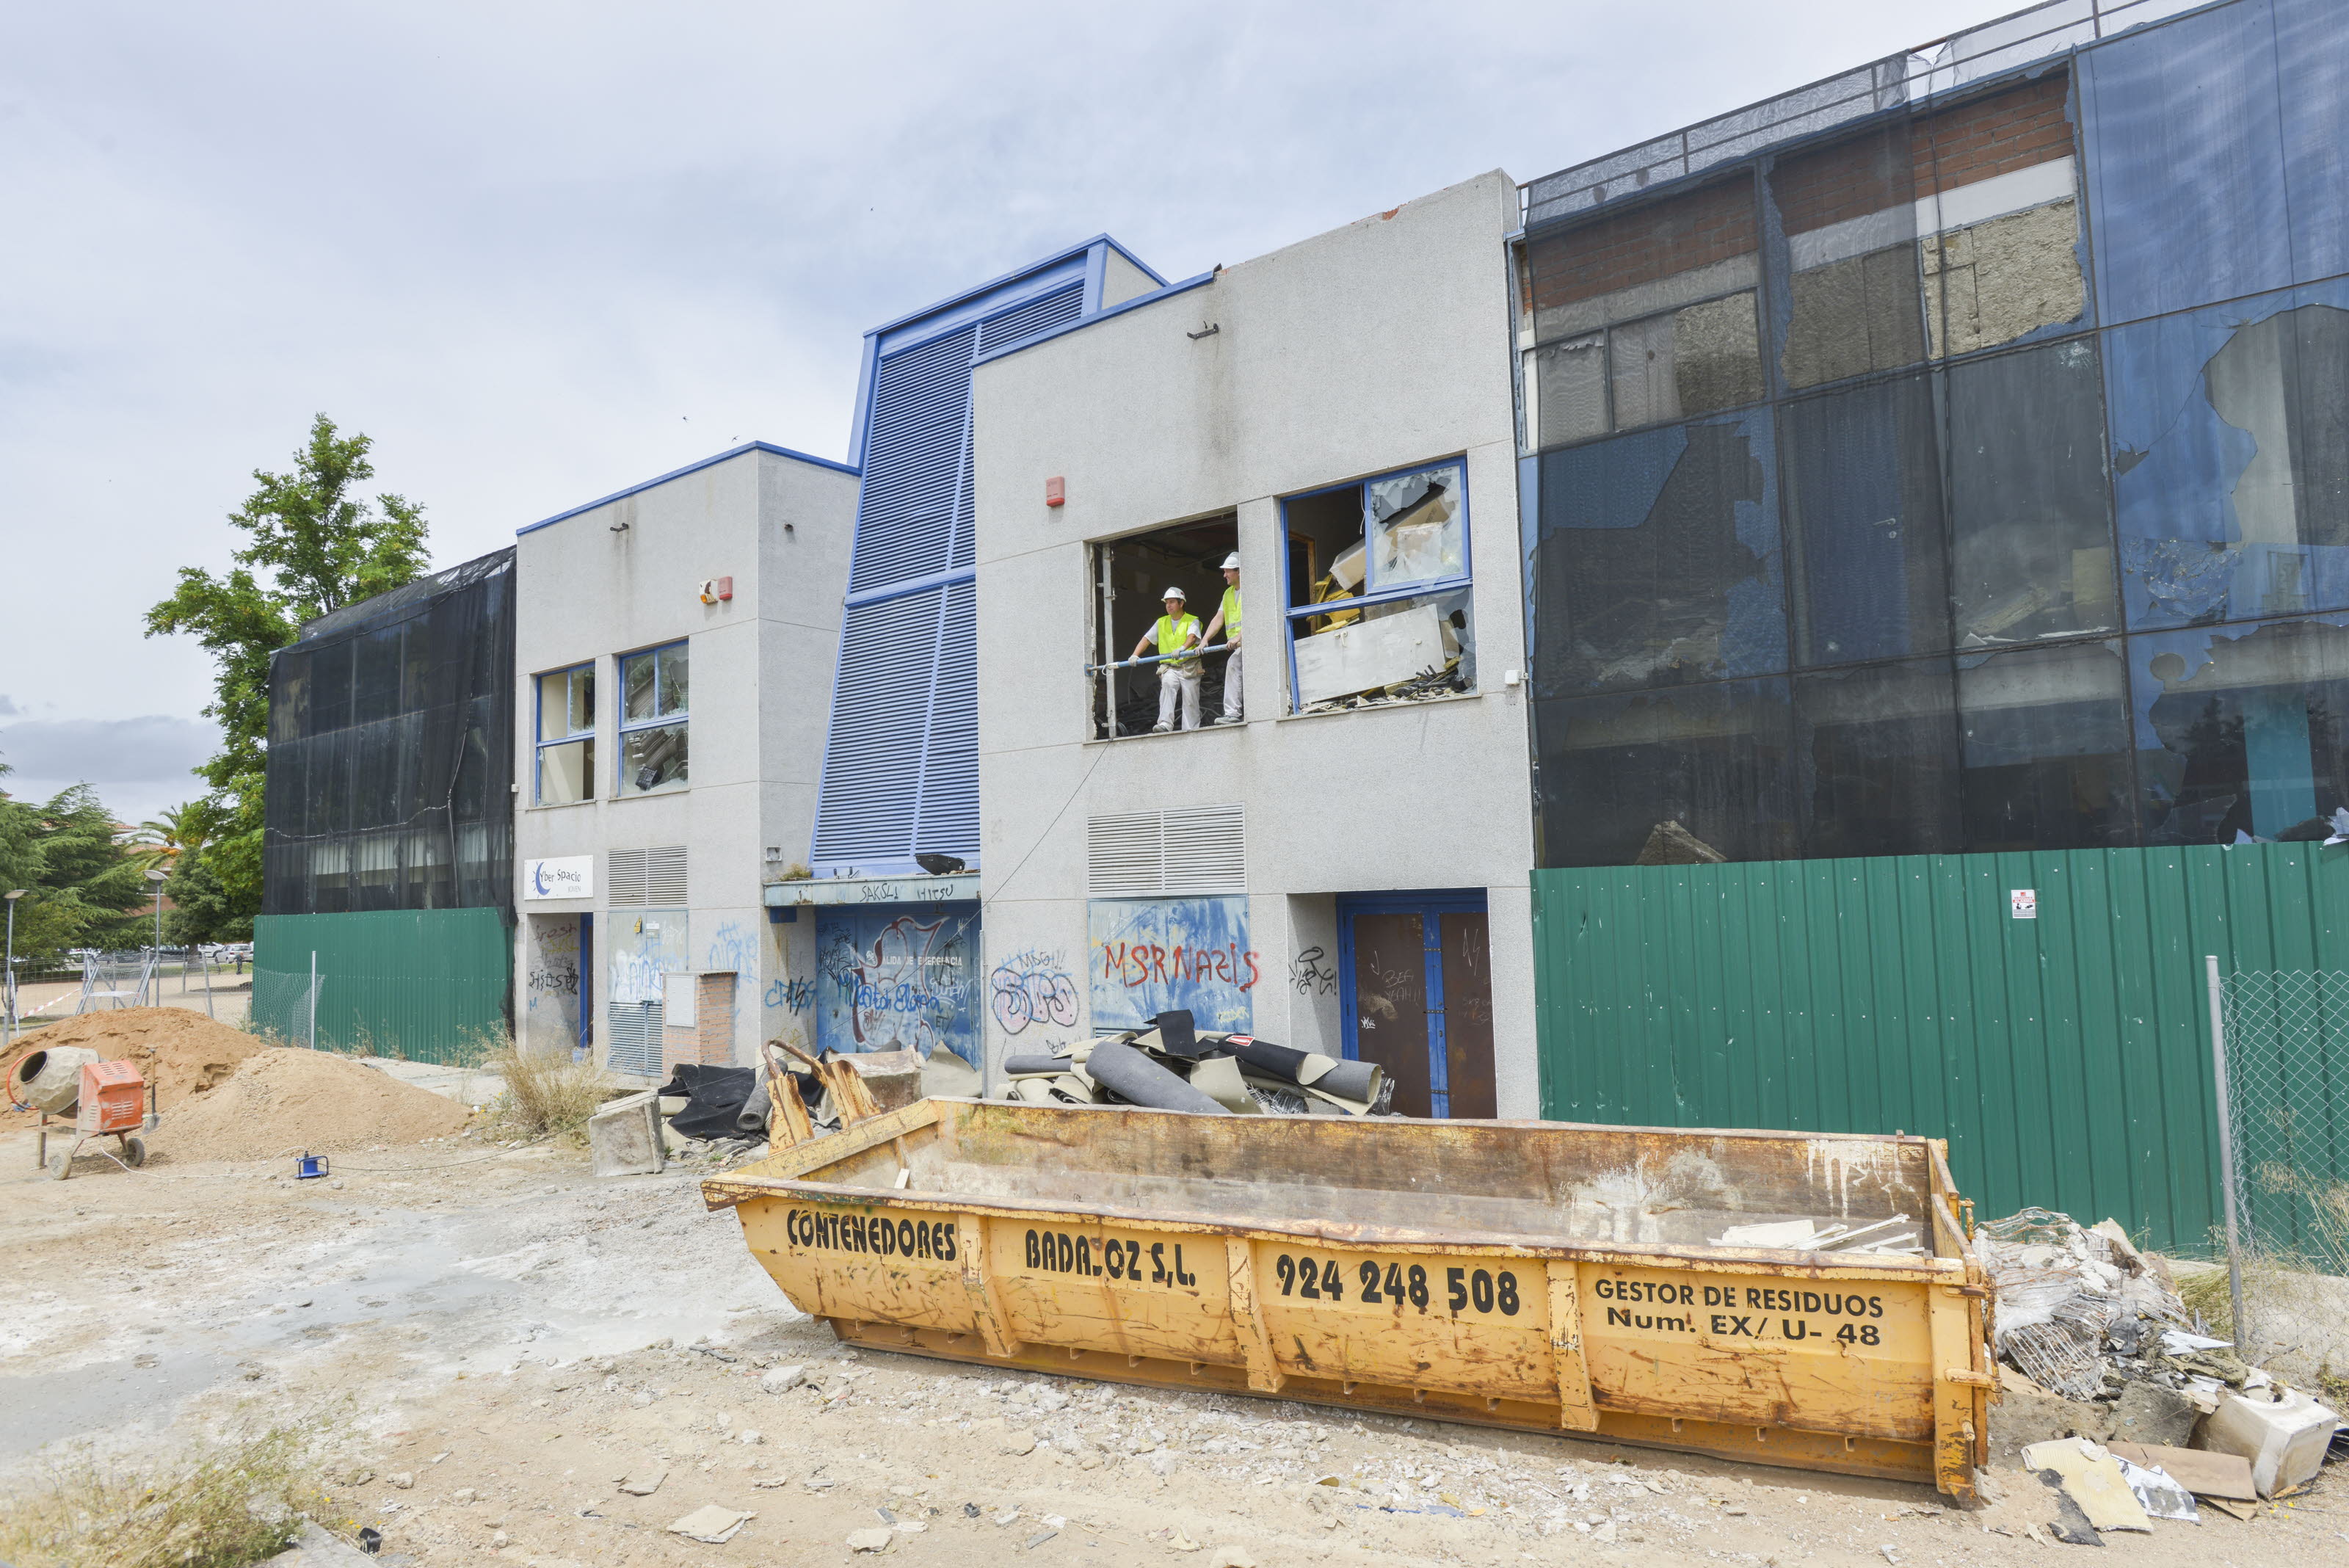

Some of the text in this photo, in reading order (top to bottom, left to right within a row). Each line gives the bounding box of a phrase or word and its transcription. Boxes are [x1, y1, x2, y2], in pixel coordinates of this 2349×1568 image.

[557, 869, 581, 882] Spacio
[567, 885, 581, 893] JOVEN
[786, 1208, 956, 1262] CONTENEDORES
[1277, 1254, 1520, 1316] 924 248 508
[1595, 1279, 1884, 1318] GESTOR DE RESIDUOS
[1606, 1307, 1696, 1334] Num.
